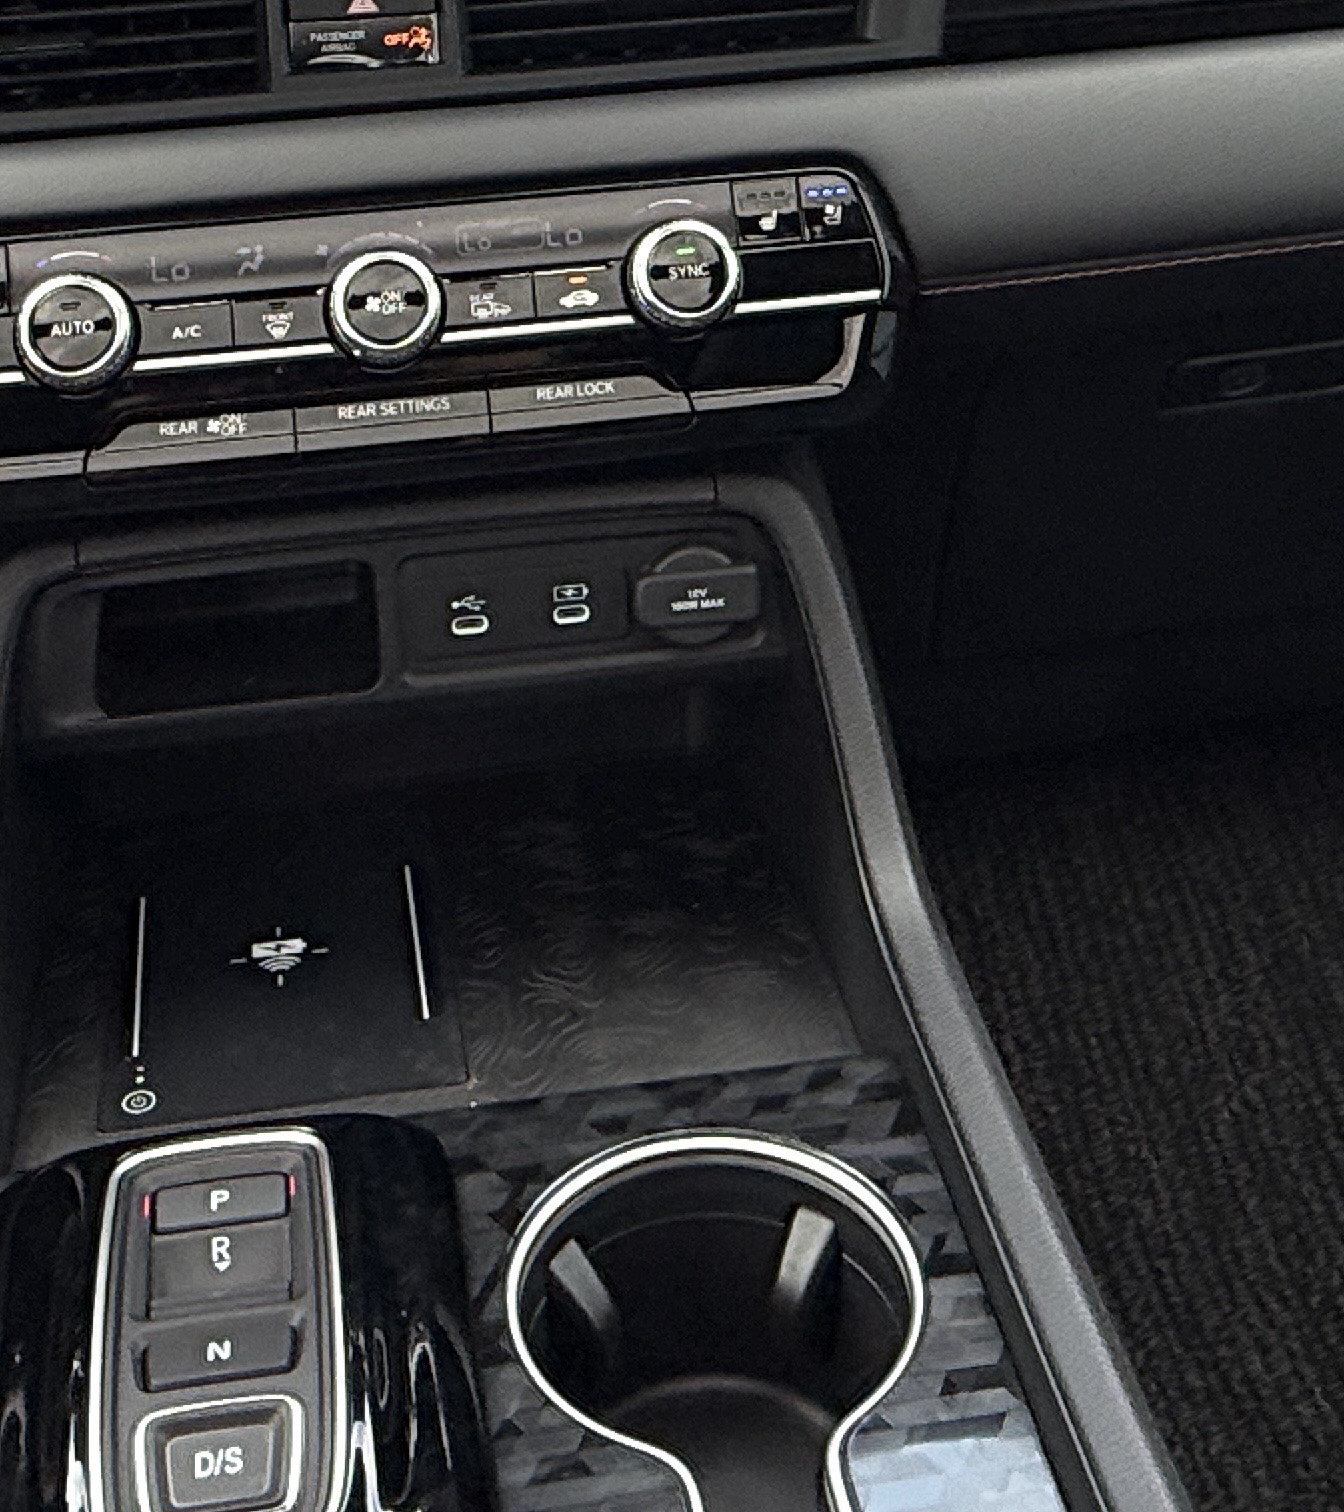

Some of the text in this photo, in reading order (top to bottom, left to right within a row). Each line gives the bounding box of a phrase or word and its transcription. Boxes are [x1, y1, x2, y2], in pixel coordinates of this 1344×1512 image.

[383, 33, 410, 46] OFF
[668, 263, 710, 280] SYNC
[382, 301, 408, 316] OFF
[51, 320, 94, 337] AUTO
[172, 324, 202, 339] A/C
[536, 380, 615, 400] REAR LOCK
[338, 397, 451, 419] REAR SETTINGS
[159, 421, 198, 435] REAR
[220, 423, 248, 436] OFF
[210, 1189, 230, 1211] P
[211, 1237, 230, 1263] R
[206, 1340, 232, 1362] N
[193, 1446, 244, 1480] D/S
